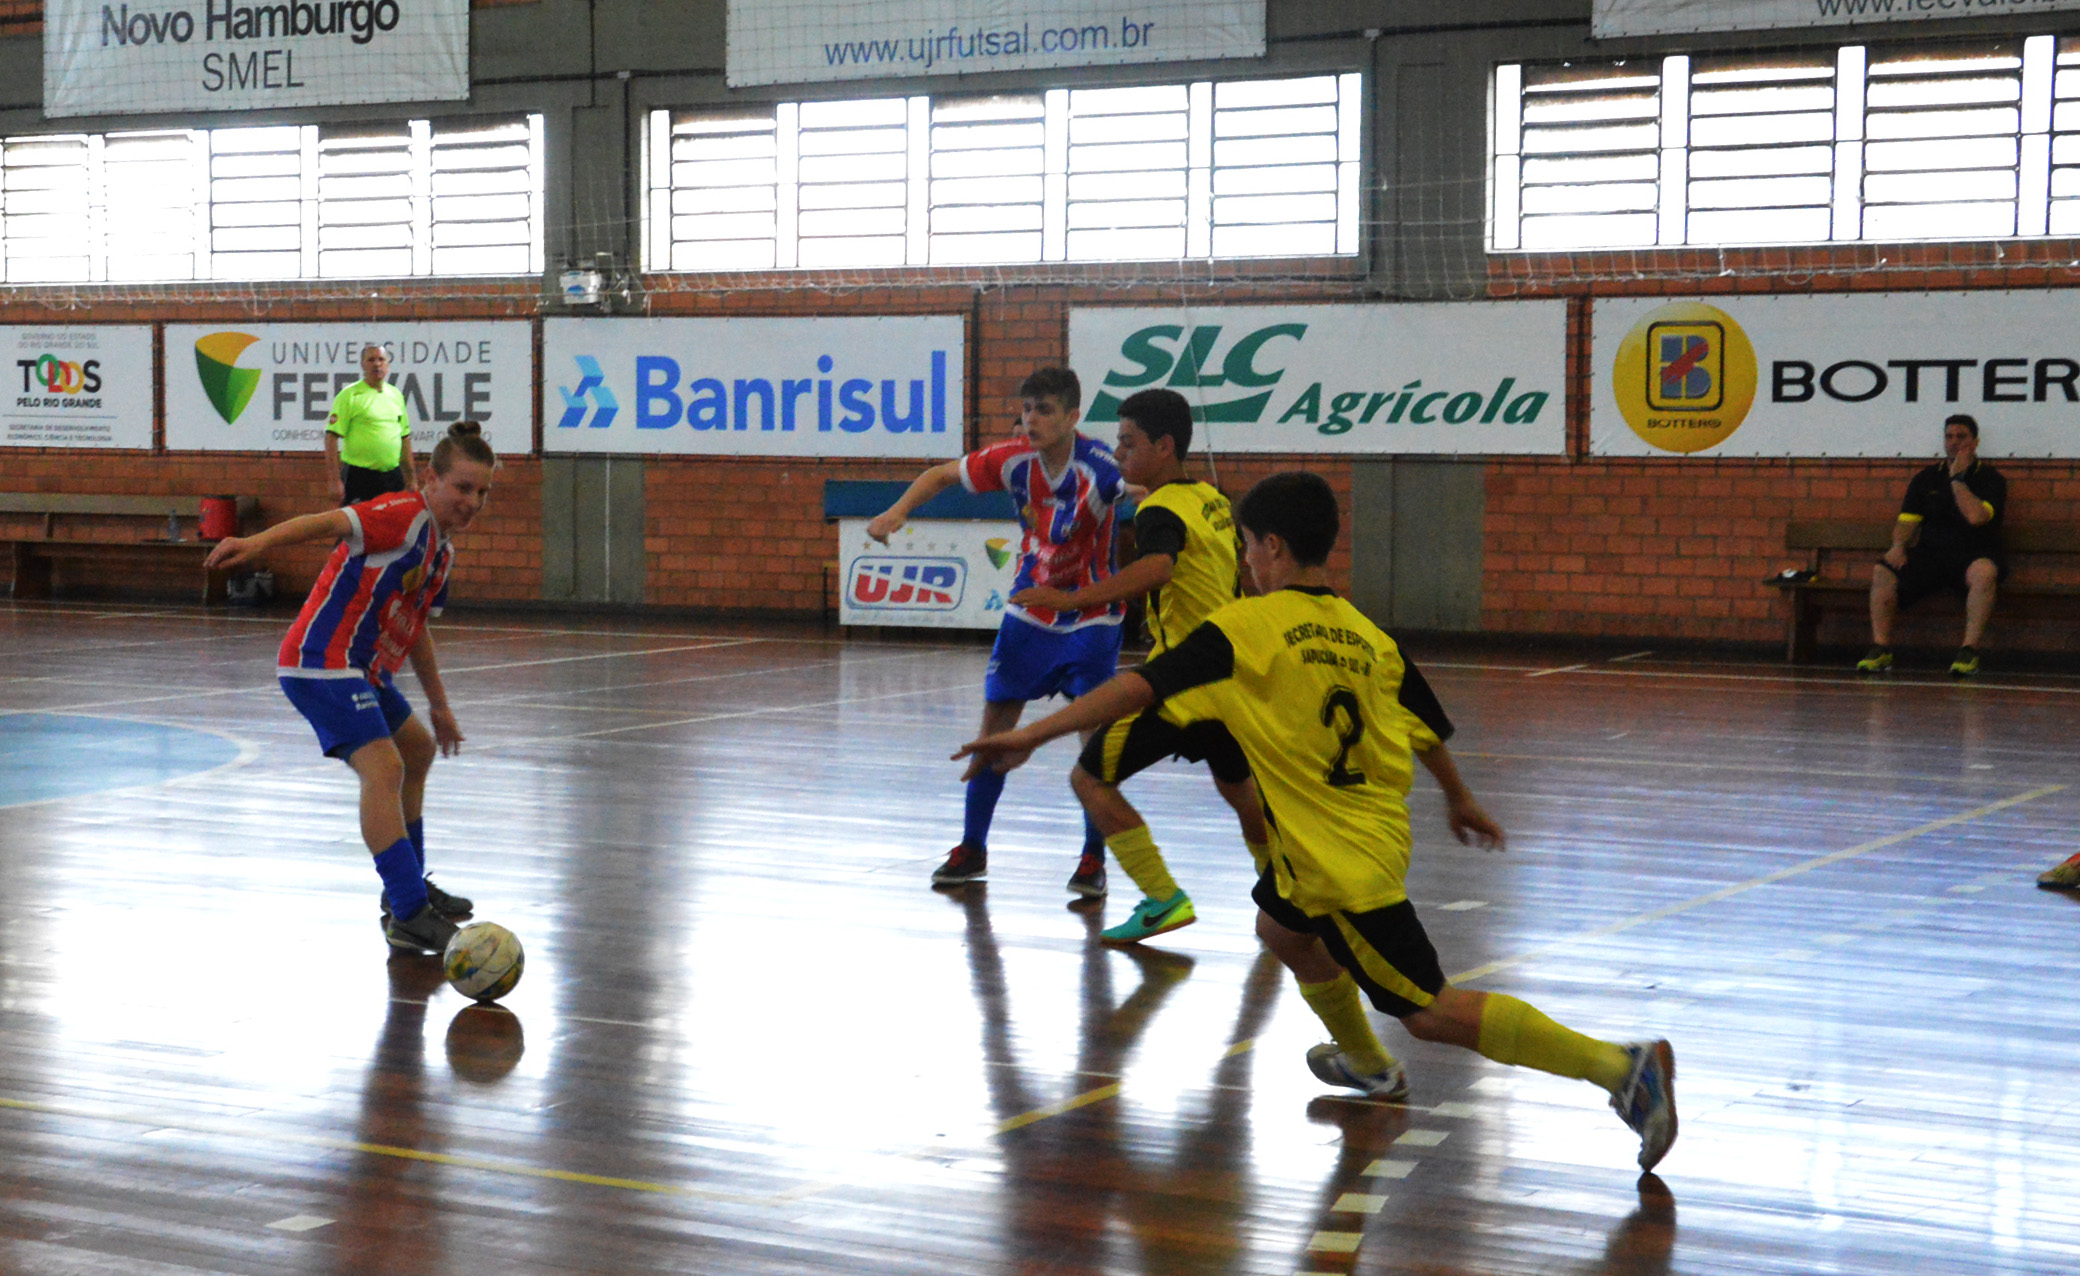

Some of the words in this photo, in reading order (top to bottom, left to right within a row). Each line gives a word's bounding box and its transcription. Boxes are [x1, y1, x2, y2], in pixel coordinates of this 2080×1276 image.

[102, 3, 194, 47] Novo
[206, 0, 400, 44] Hamburgo
[825, 19, 1155, 67] www.ujrfutsal.com.br
[202, 49, 305, 92] SMEL
[17, 354, 102, 394] TODOS
[272, 341, 491, 365] UNIVESIDADE
[1103, 323, 1309, 387] SLC
[16, 398, 41, 408] PELO
[43, 398, 60, 408] RIO
[62, 398, 102, 408] GRANDE
[635, 350, 946, 433] Banrisul
[1772, 357, 2080, 403] BOTTER
[1277, 377, 1550, 435] Agrícola
[855, 565, 957, 604] UJR
[1329, 627, 1345, 644] DE
[1320, 684, 1367, 787] 2
